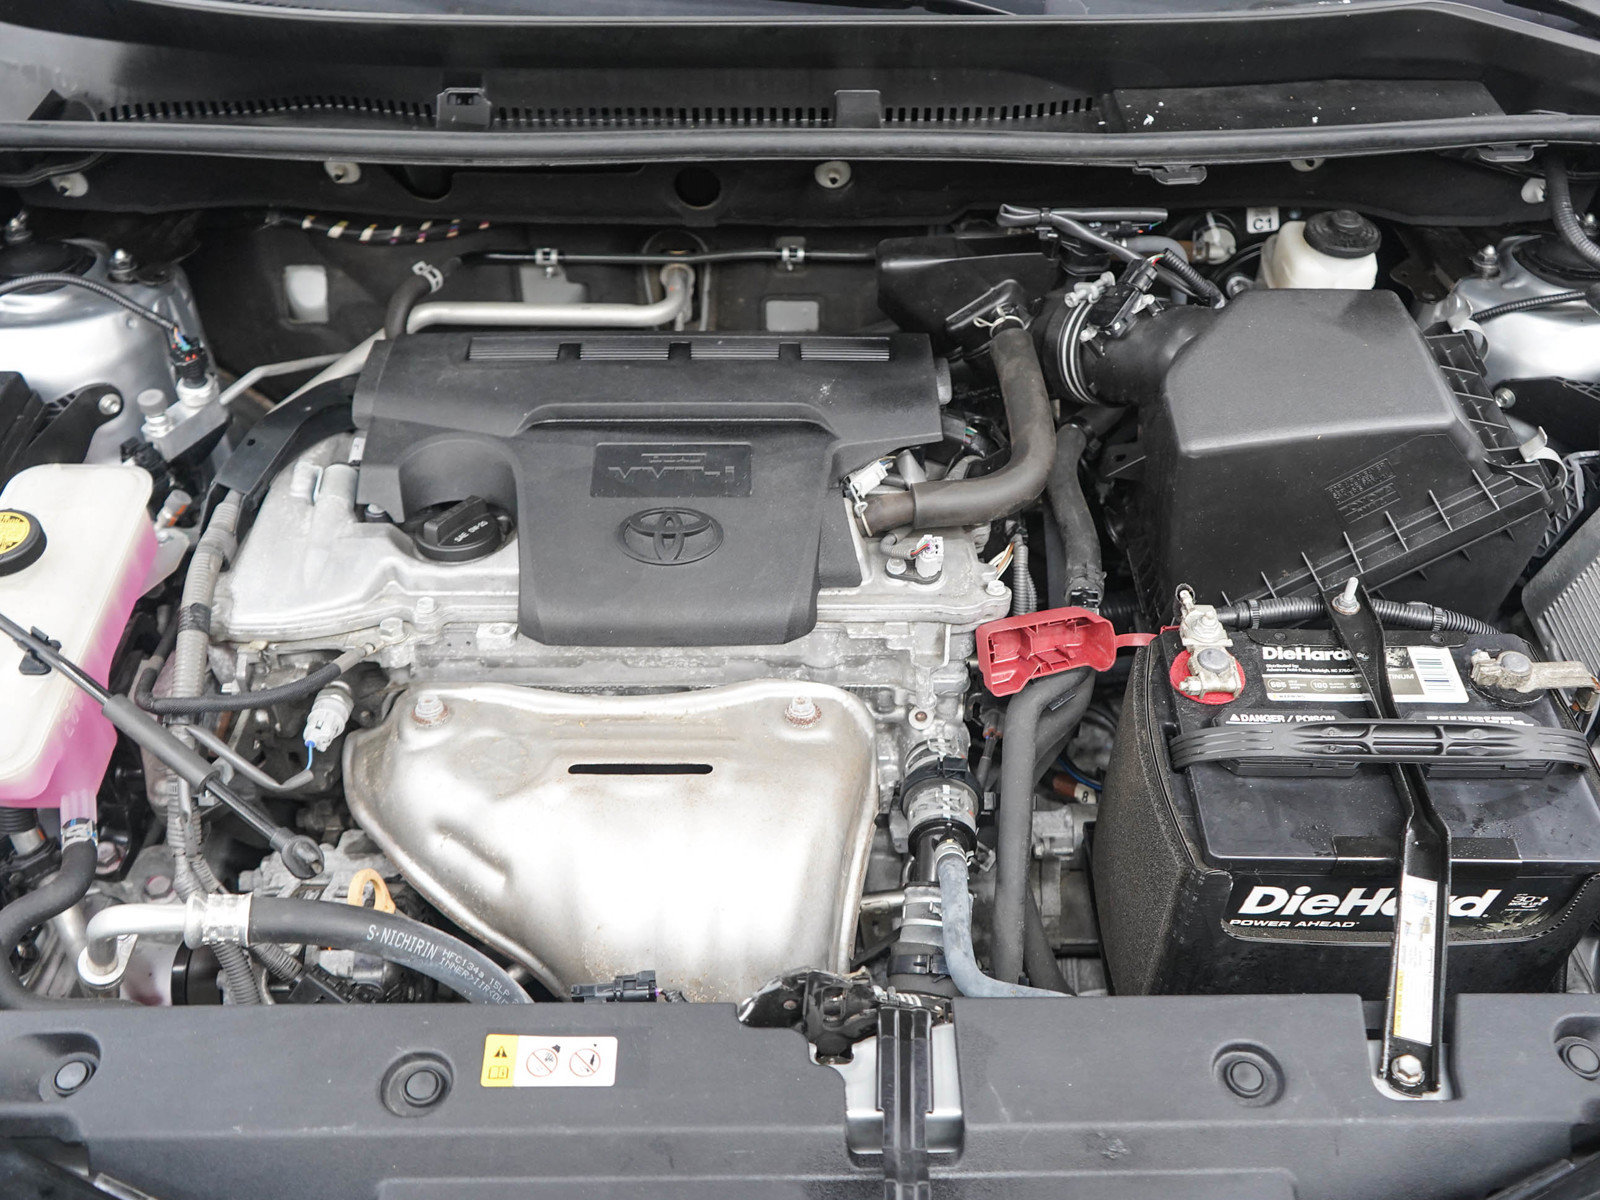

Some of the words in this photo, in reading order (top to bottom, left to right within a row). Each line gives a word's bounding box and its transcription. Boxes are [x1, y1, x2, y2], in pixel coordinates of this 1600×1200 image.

[1252, 218, 1273, 231] C1
[1239, 713, 1286, 723] DANGER
[1238, 886, 1502, 917] DieHd
[1229, 919, 1291, 927] POWER
